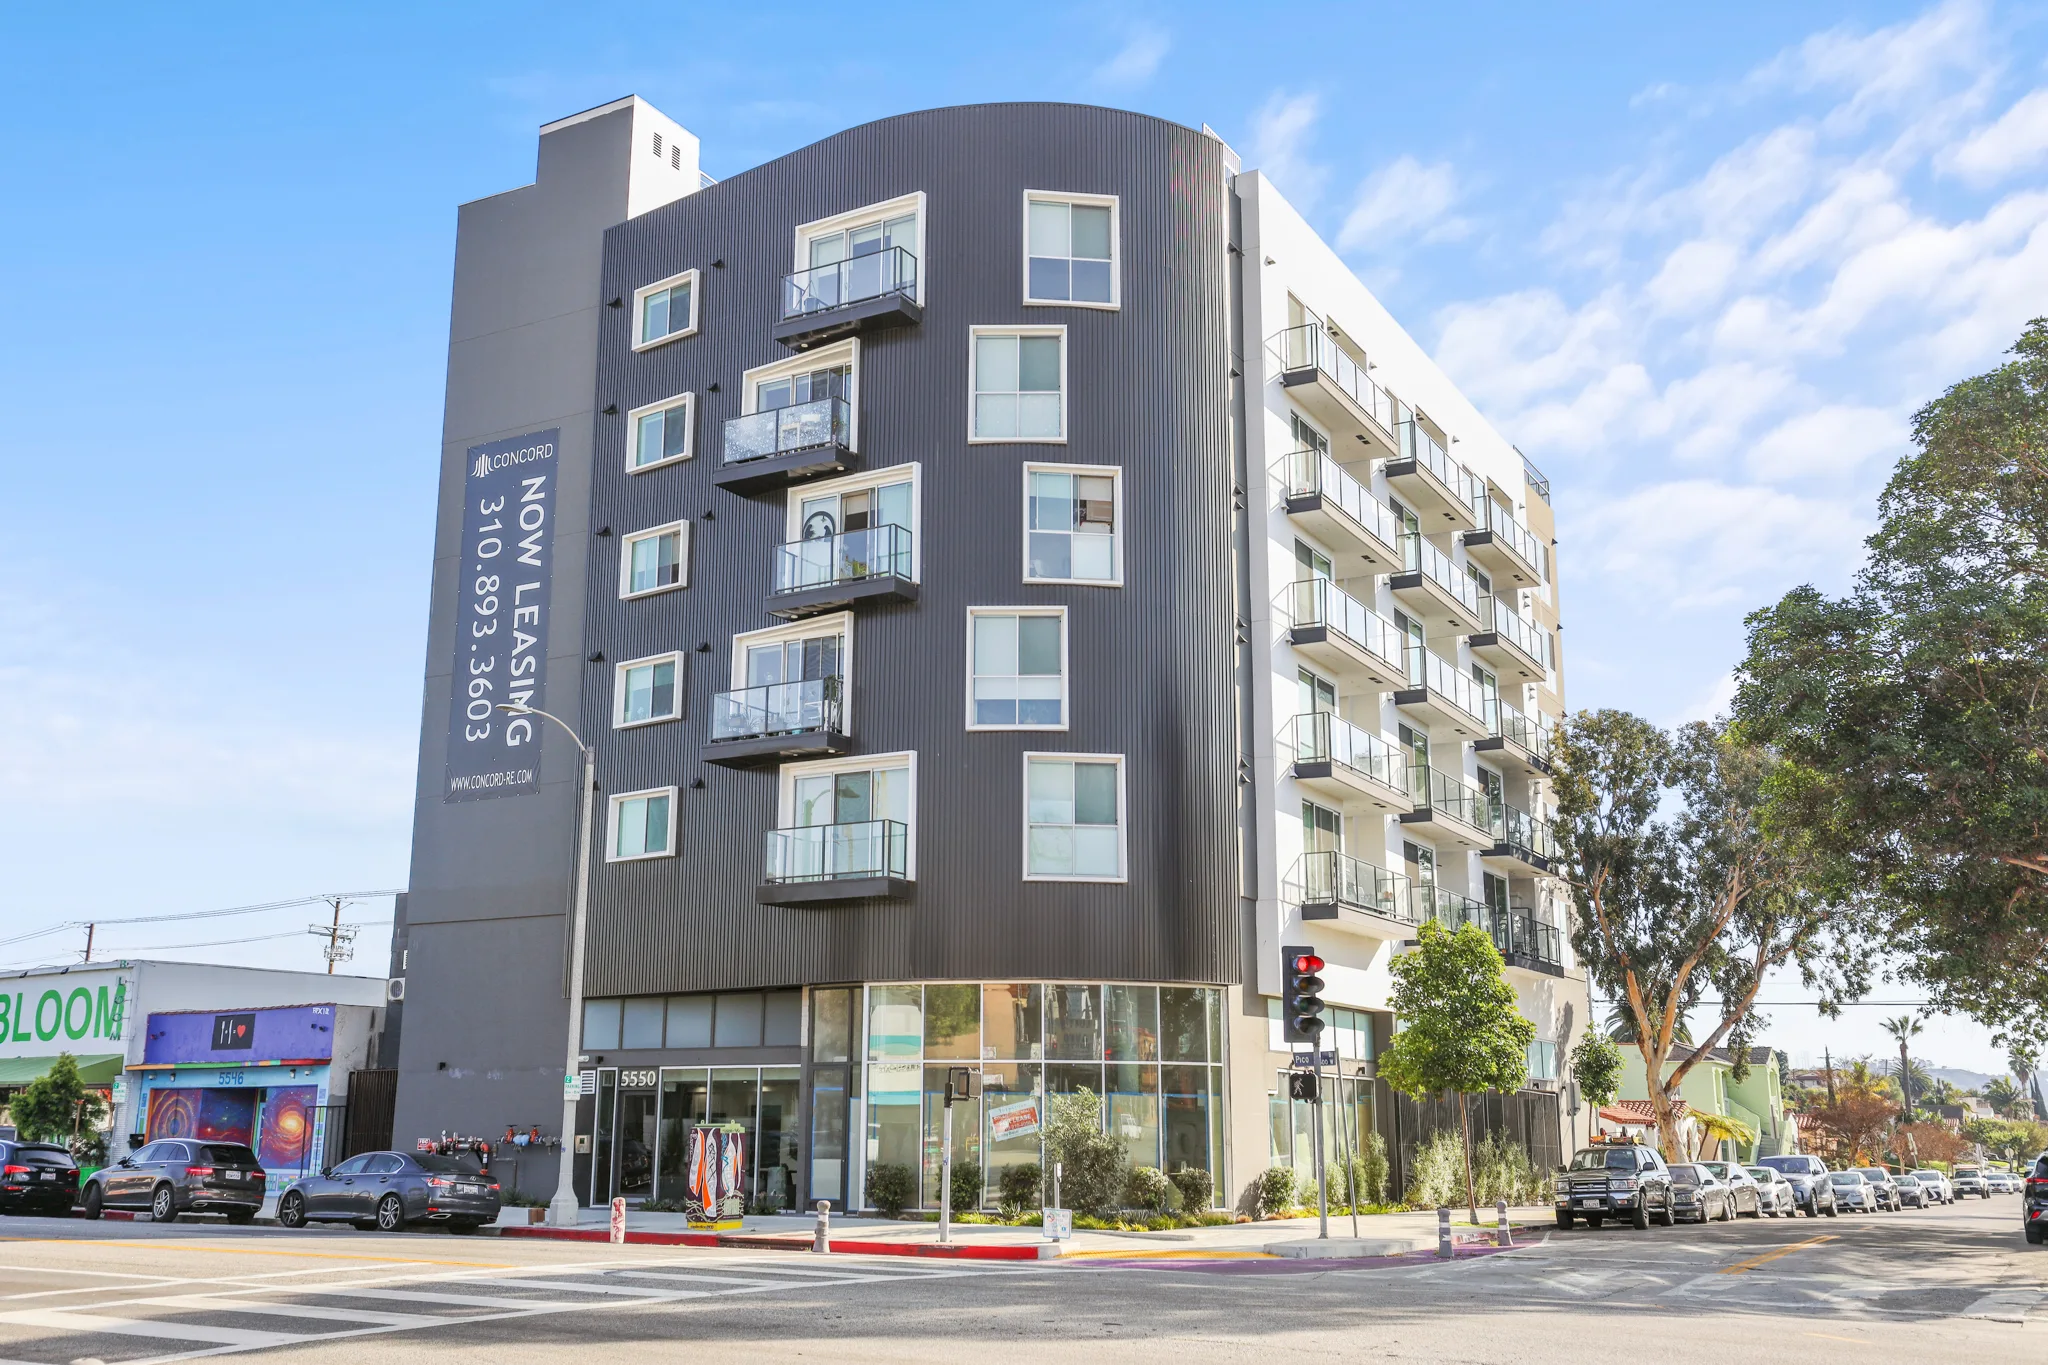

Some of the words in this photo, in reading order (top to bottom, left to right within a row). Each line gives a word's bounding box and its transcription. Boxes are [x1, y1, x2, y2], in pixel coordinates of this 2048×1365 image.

[493, 443, 553, 469] CONCORD
[517, 475, 547, 567] NOW
[465, 495, 505, 742] 310.893.3603
[506, 581, 541, 747] LEASING
[450, 769, 533, 792] WWW.CONCORD-RE.COM
[1295, 1055, 1309, 1064] Pico
[219, 1072, 244, 1085] 5546
[620, 1070, 656, 1087] 5550
